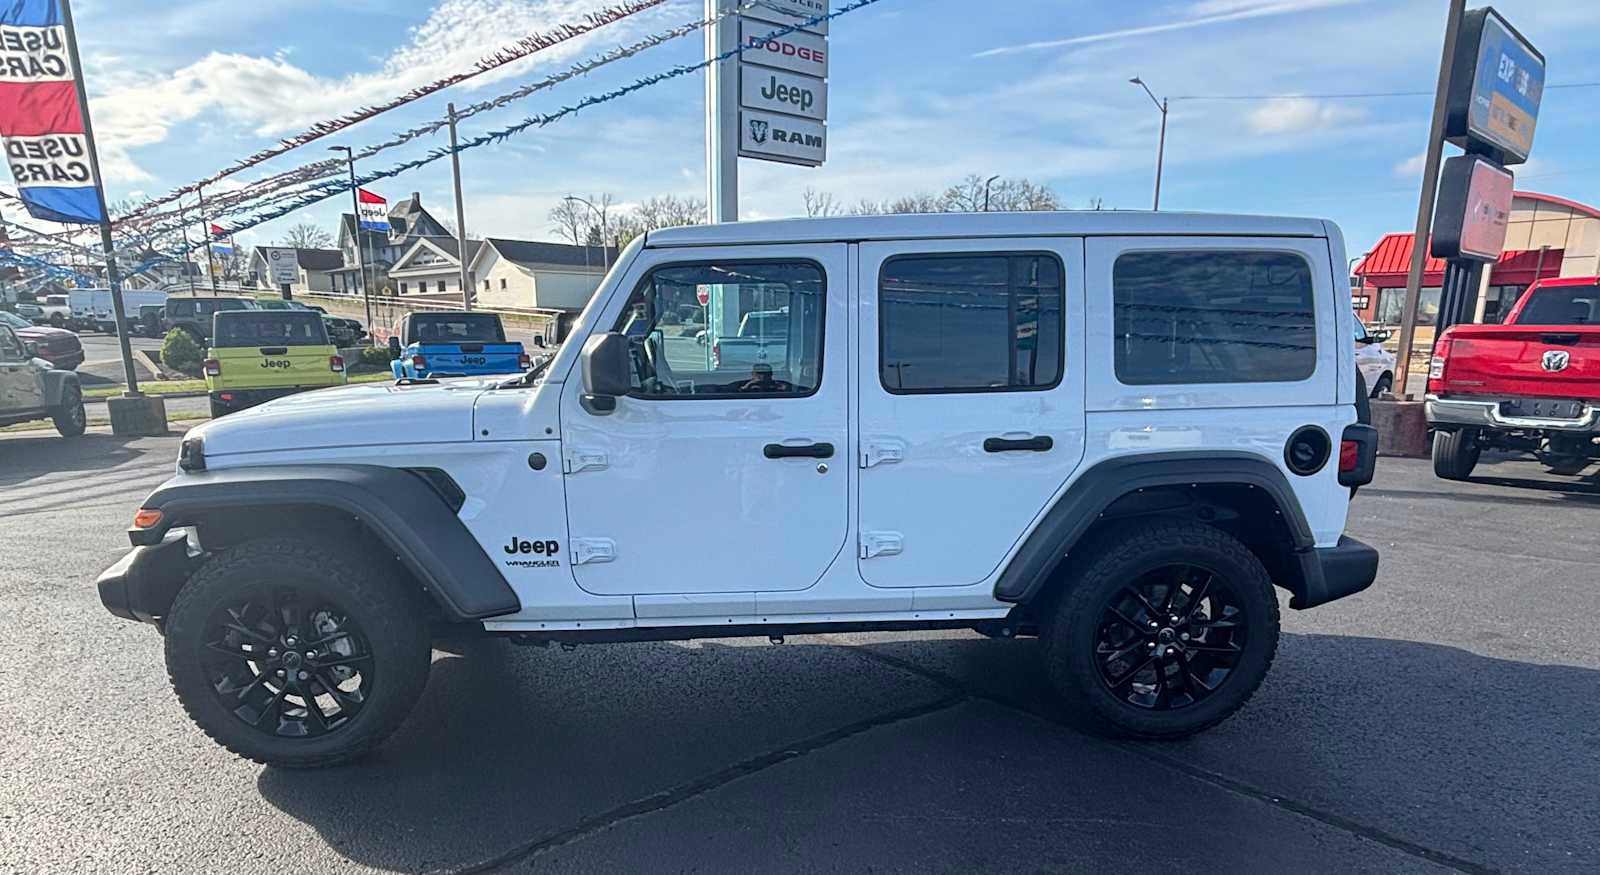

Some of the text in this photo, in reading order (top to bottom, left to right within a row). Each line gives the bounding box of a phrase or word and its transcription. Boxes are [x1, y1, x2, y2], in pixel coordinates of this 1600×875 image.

[749, 36, 824, 63] DODGE
[761, 76, 813, 111] Jeep
[772, 128, 822, 148] RAM
[261, 359, 291, 369] Jeep
[504, 536, 559, 557] Jeep
